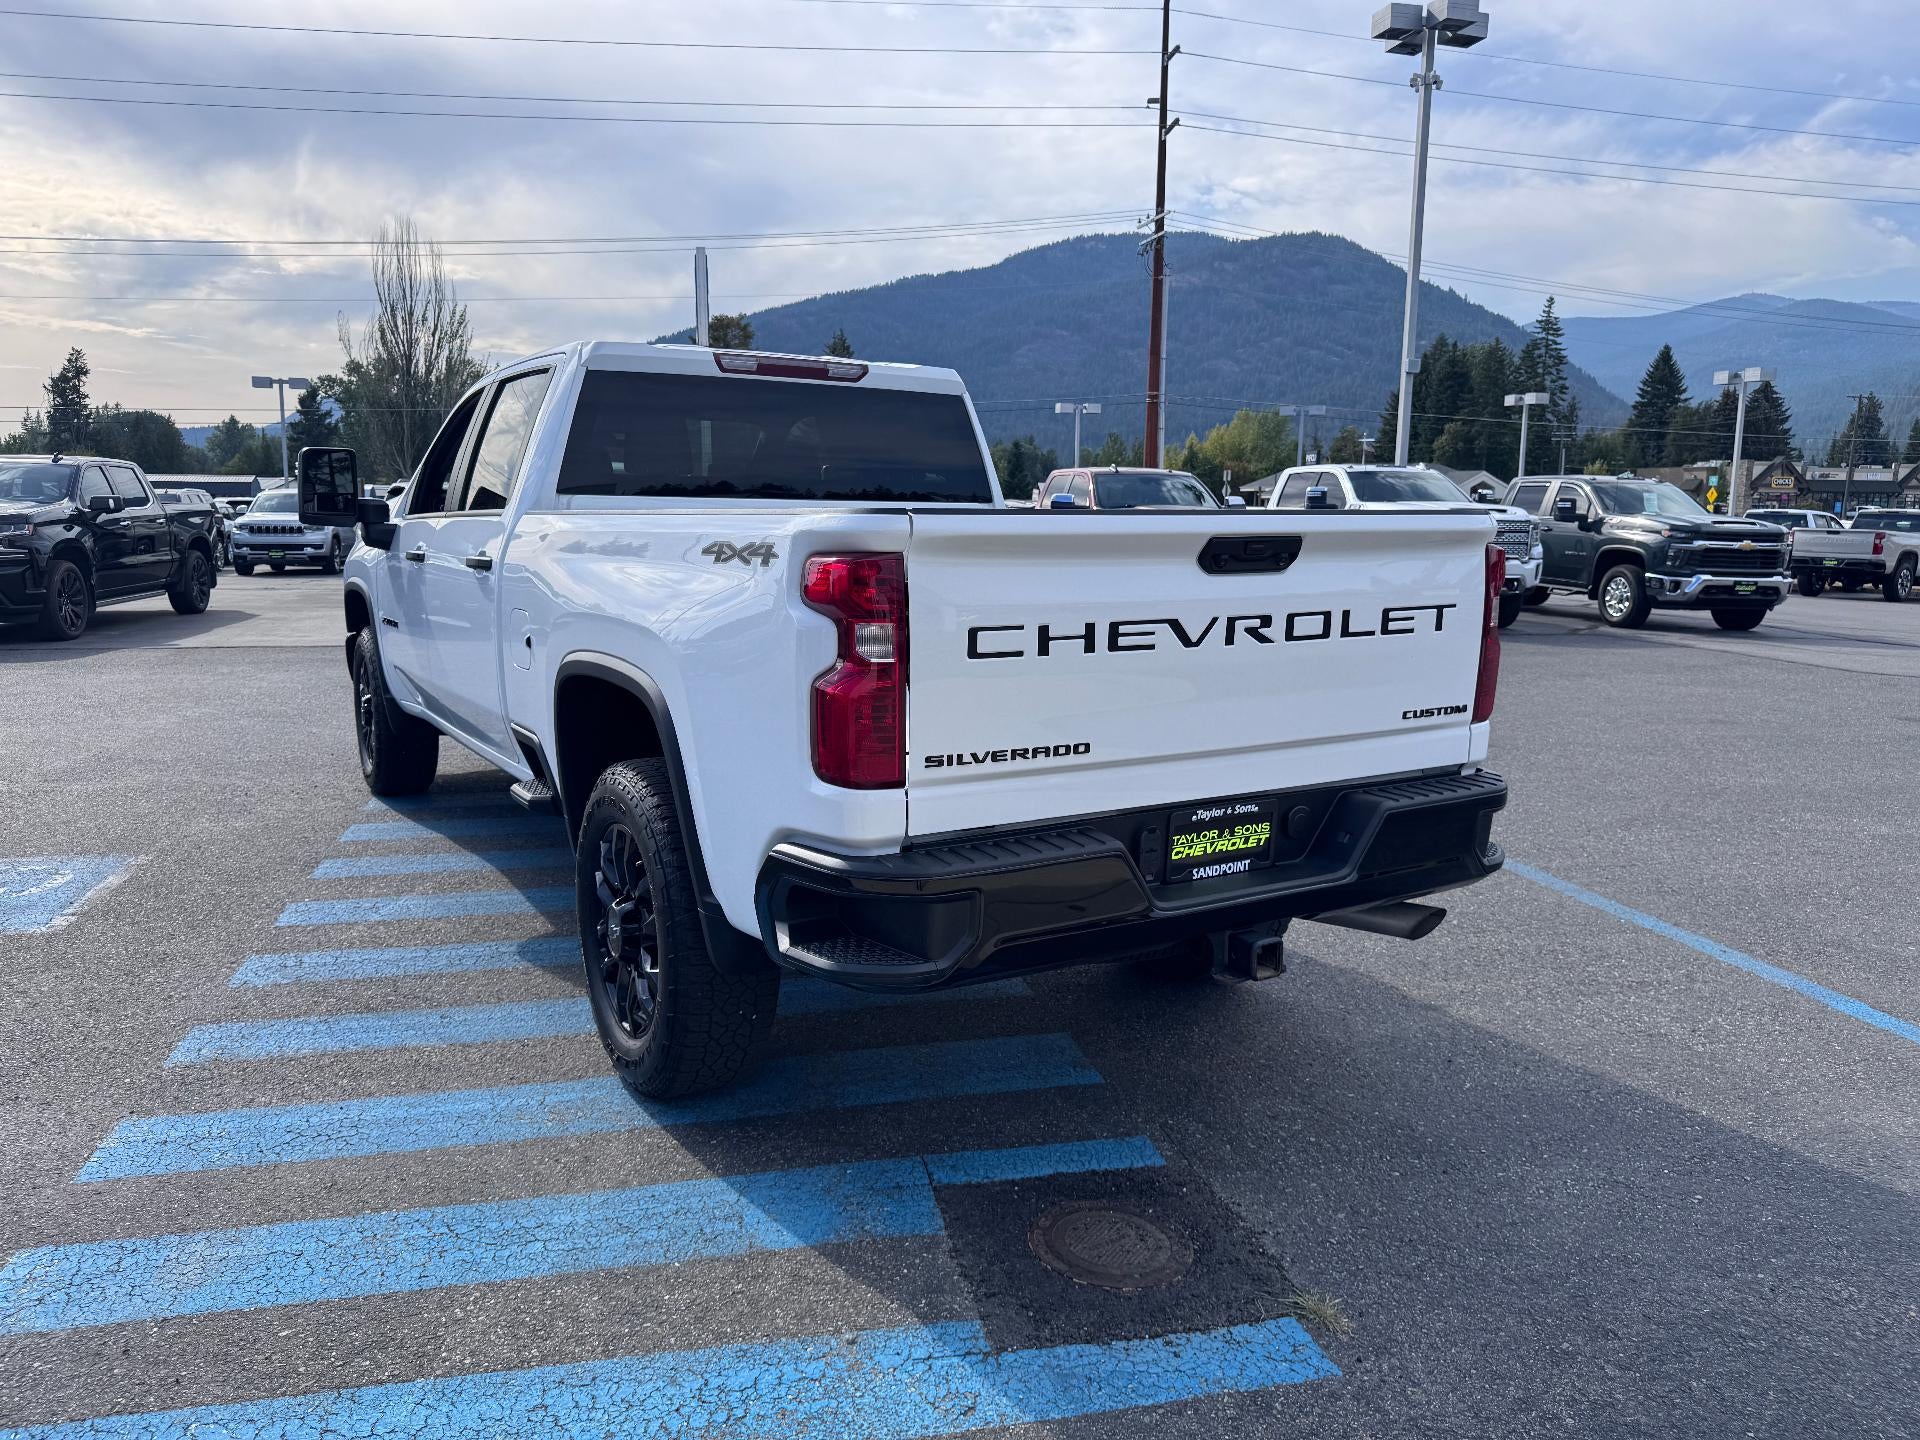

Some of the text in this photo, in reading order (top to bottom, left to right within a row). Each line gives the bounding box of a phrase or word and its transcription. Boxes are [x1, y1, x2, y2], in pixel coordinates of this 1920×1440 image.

[967, 603, 1457, 659] CHEVROLET
[1402, 704, 1468, 719] CUSTOM
[924, 742, 1091, 769] SILVERADO
[1173, 823, 1270, 845] TAYLOR & SONS
[1172, 834, 1270, 860] CHEVROLET
[1192, 860, 1251, 879] SANDPOINT
